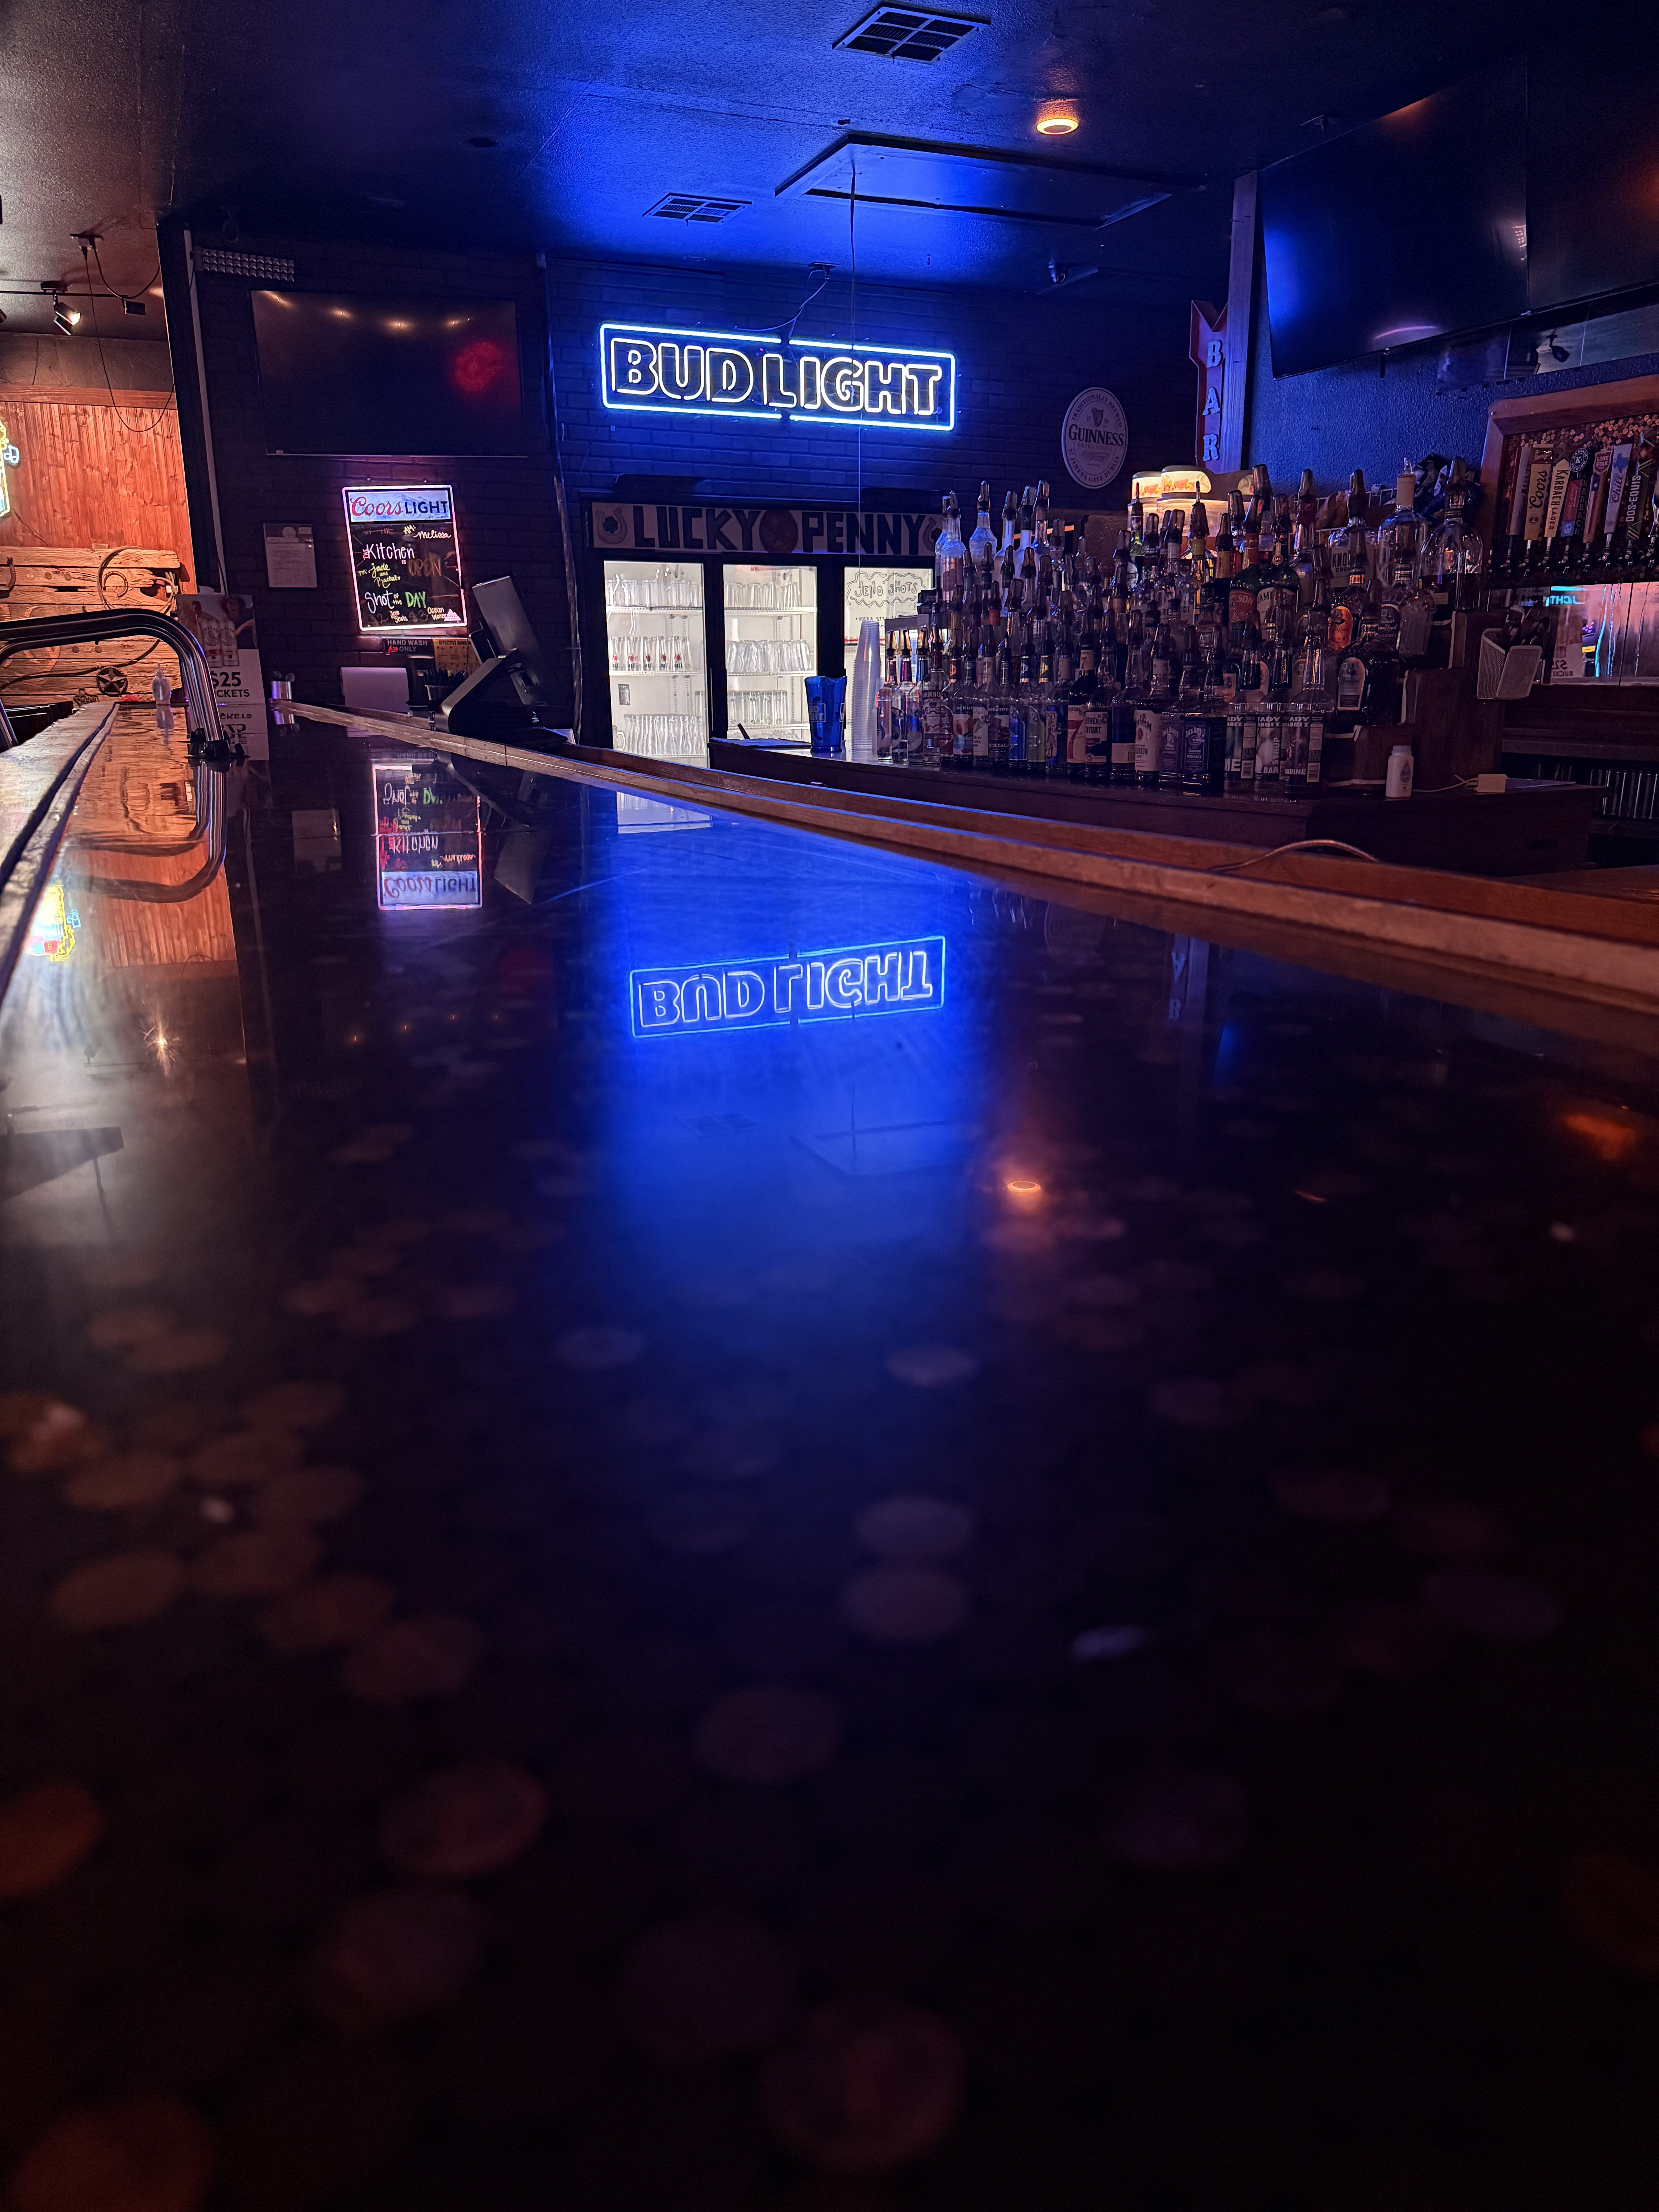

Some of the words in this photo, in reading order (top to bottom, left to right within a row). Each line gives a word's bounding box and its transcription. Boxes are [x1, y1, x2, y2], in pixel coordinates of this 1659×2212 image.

[611, 338, 754, 403] BUD
[763, 353, 942, 416] LIGHT
[1202, 340, 1223, 462] BAR
[1068, 424, 1124, 446] GUINNESS
[1529, 470, 1547, 508] Coors
[1551, 469, 1569, 506] KARBACH
[349, 496, 404, 517] Coors
[405, 501, 448, 514] LIGHT
[1548, 507, 1556, 530] LAGER
[632, 505, 762, 551] LUCKY
[802, 511, 928, 555] PENNY
[367, 542, 415, 560] Kitchen
[408, 558, 442, 577] OPEN
[404, 591, 426, 608] DAY
[215, 689, 250, 697] CKETS
